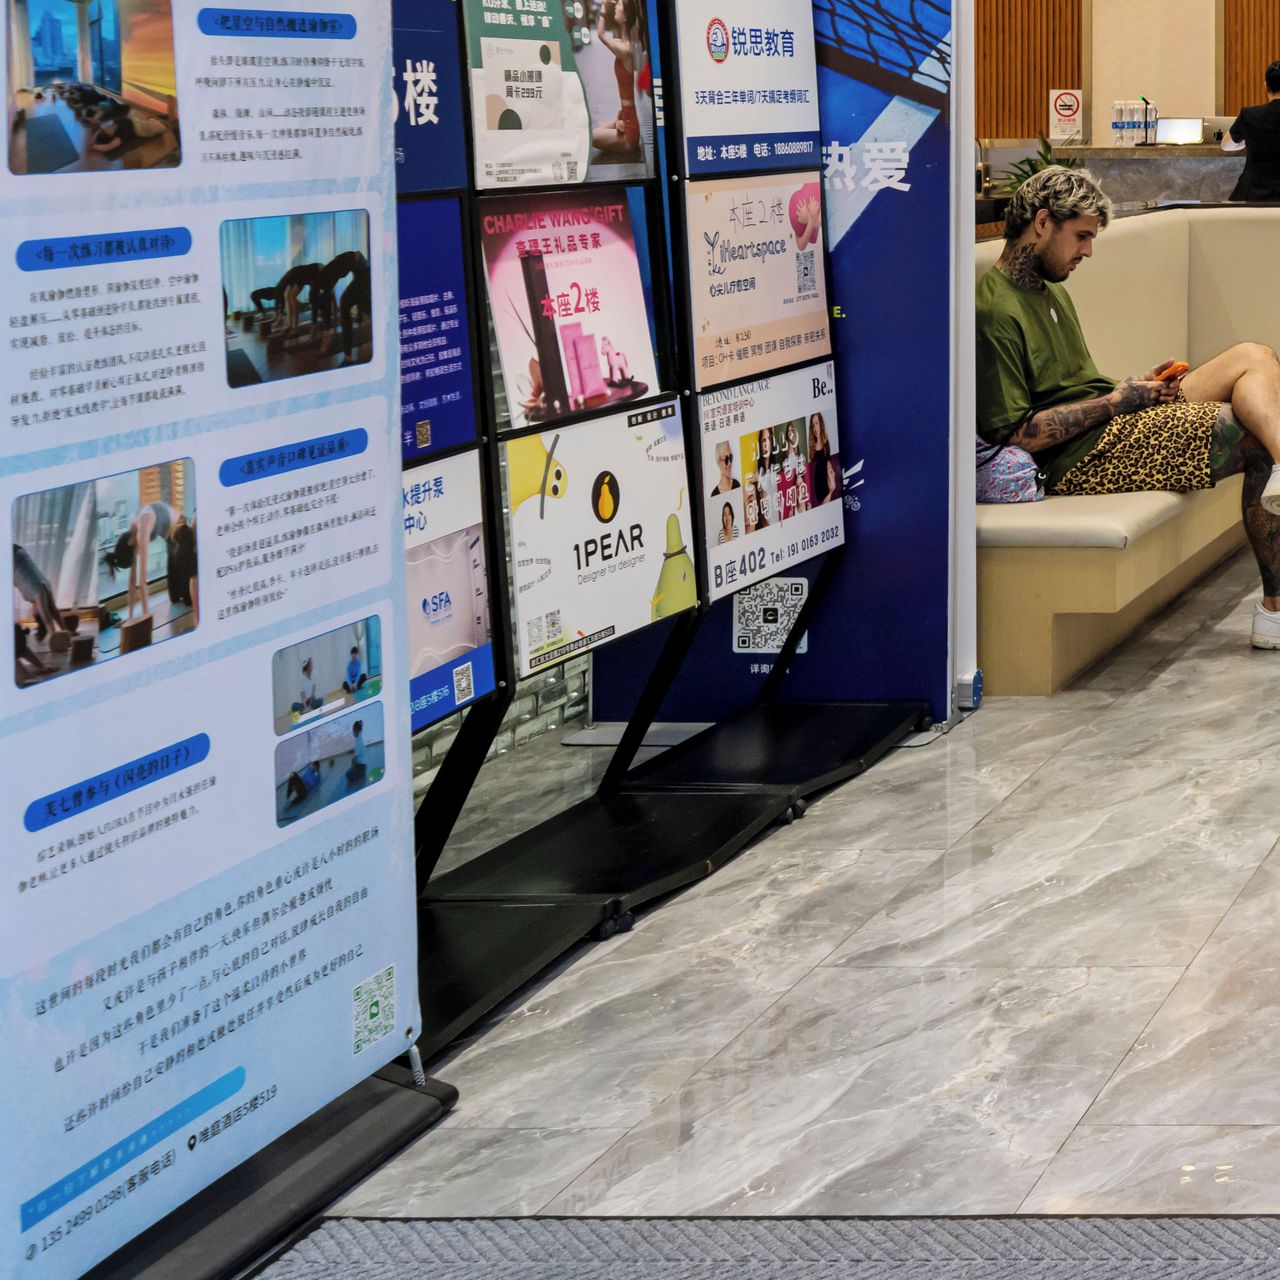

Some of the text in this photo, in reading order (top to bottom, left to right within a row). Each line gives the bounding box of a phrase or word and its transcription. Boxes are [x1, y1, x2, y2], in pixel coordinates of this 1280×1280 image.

[731, 27, 795, 58] 锐思教育
[484, 205, 624, 235] CHARLIE WANG GIFT
[541, 282, 601, 320] 本座2楼
[702, 388, 733, 407] BEYOND
[573, 523, 644, 570] 1PEAR
[715, 547, 766, 588] B座402
[787, 543, 799, 558] 191
[801, 535, 819, 551] 0163
[821, 526, 839, 543] 2032
[578, 554, 646, 585] Designer for designer
[432, 592, 452, 612] SFA
